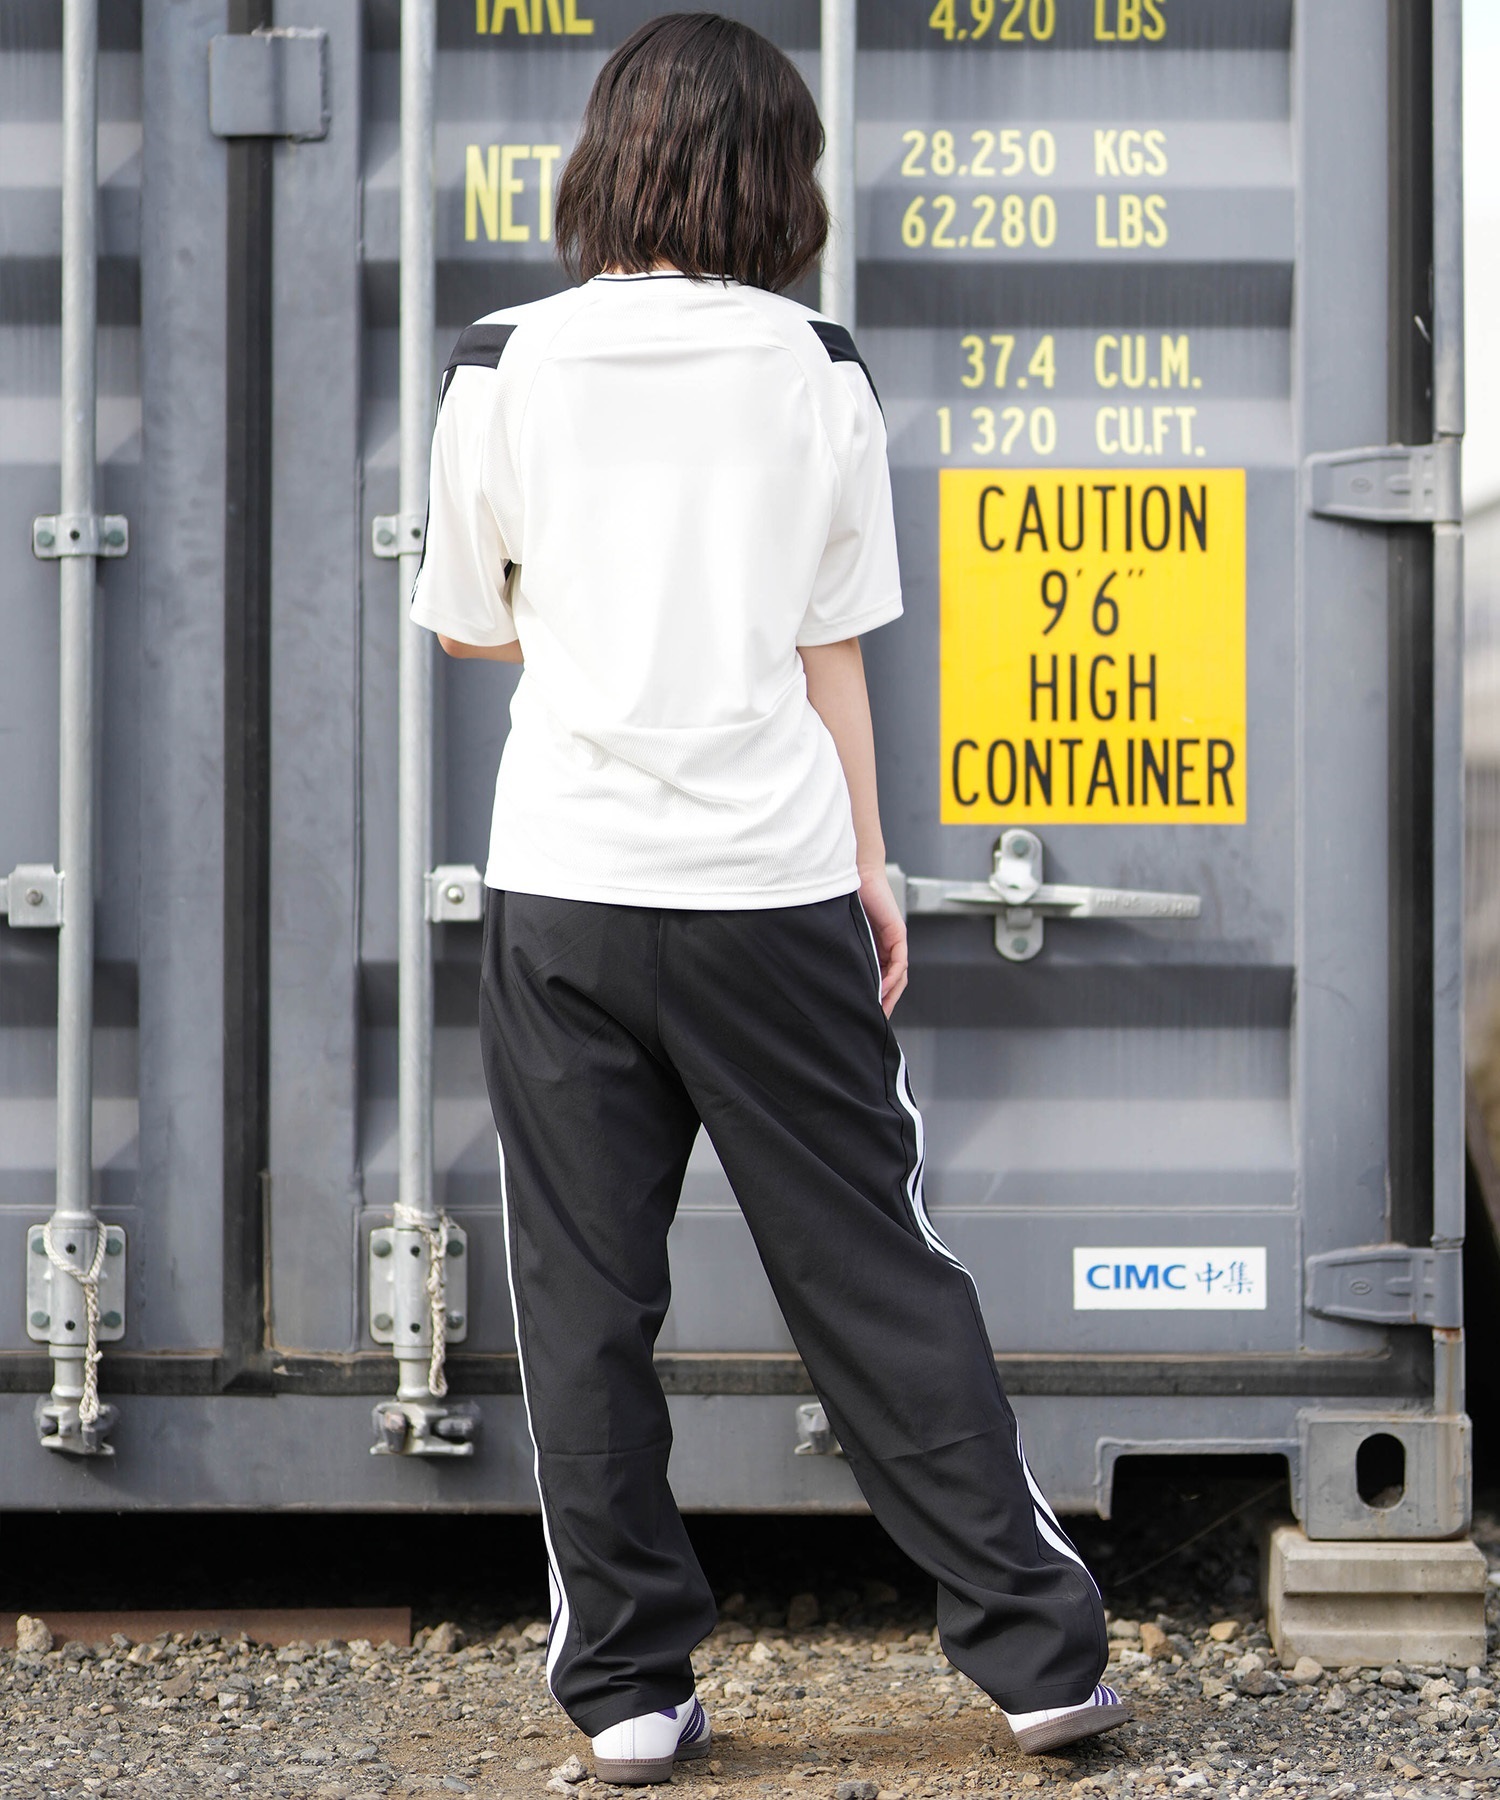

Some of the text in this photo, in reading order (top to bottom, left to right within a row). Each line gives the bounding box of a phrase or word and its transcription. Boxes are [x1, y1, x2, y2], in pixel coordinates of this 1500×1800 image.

[1094, 0, 1167, 41] LBS
[1093, 129, 1168, 177] KGS
[465, 144, 562, 243] NET
[1095, 194, 1168, 249] LBS
[960, 334, 1203, 389] 37.4 CU.M.
[1095, 406, 1206, 457] CU.FT.
[977, 484, 1207, 553] CAUTION
[1030, 653, 1157, 722] HIGH
[951, 737, 1236, 807] CONTAINER
[1086, 1261, 1254, 1294] CIMC 中集
